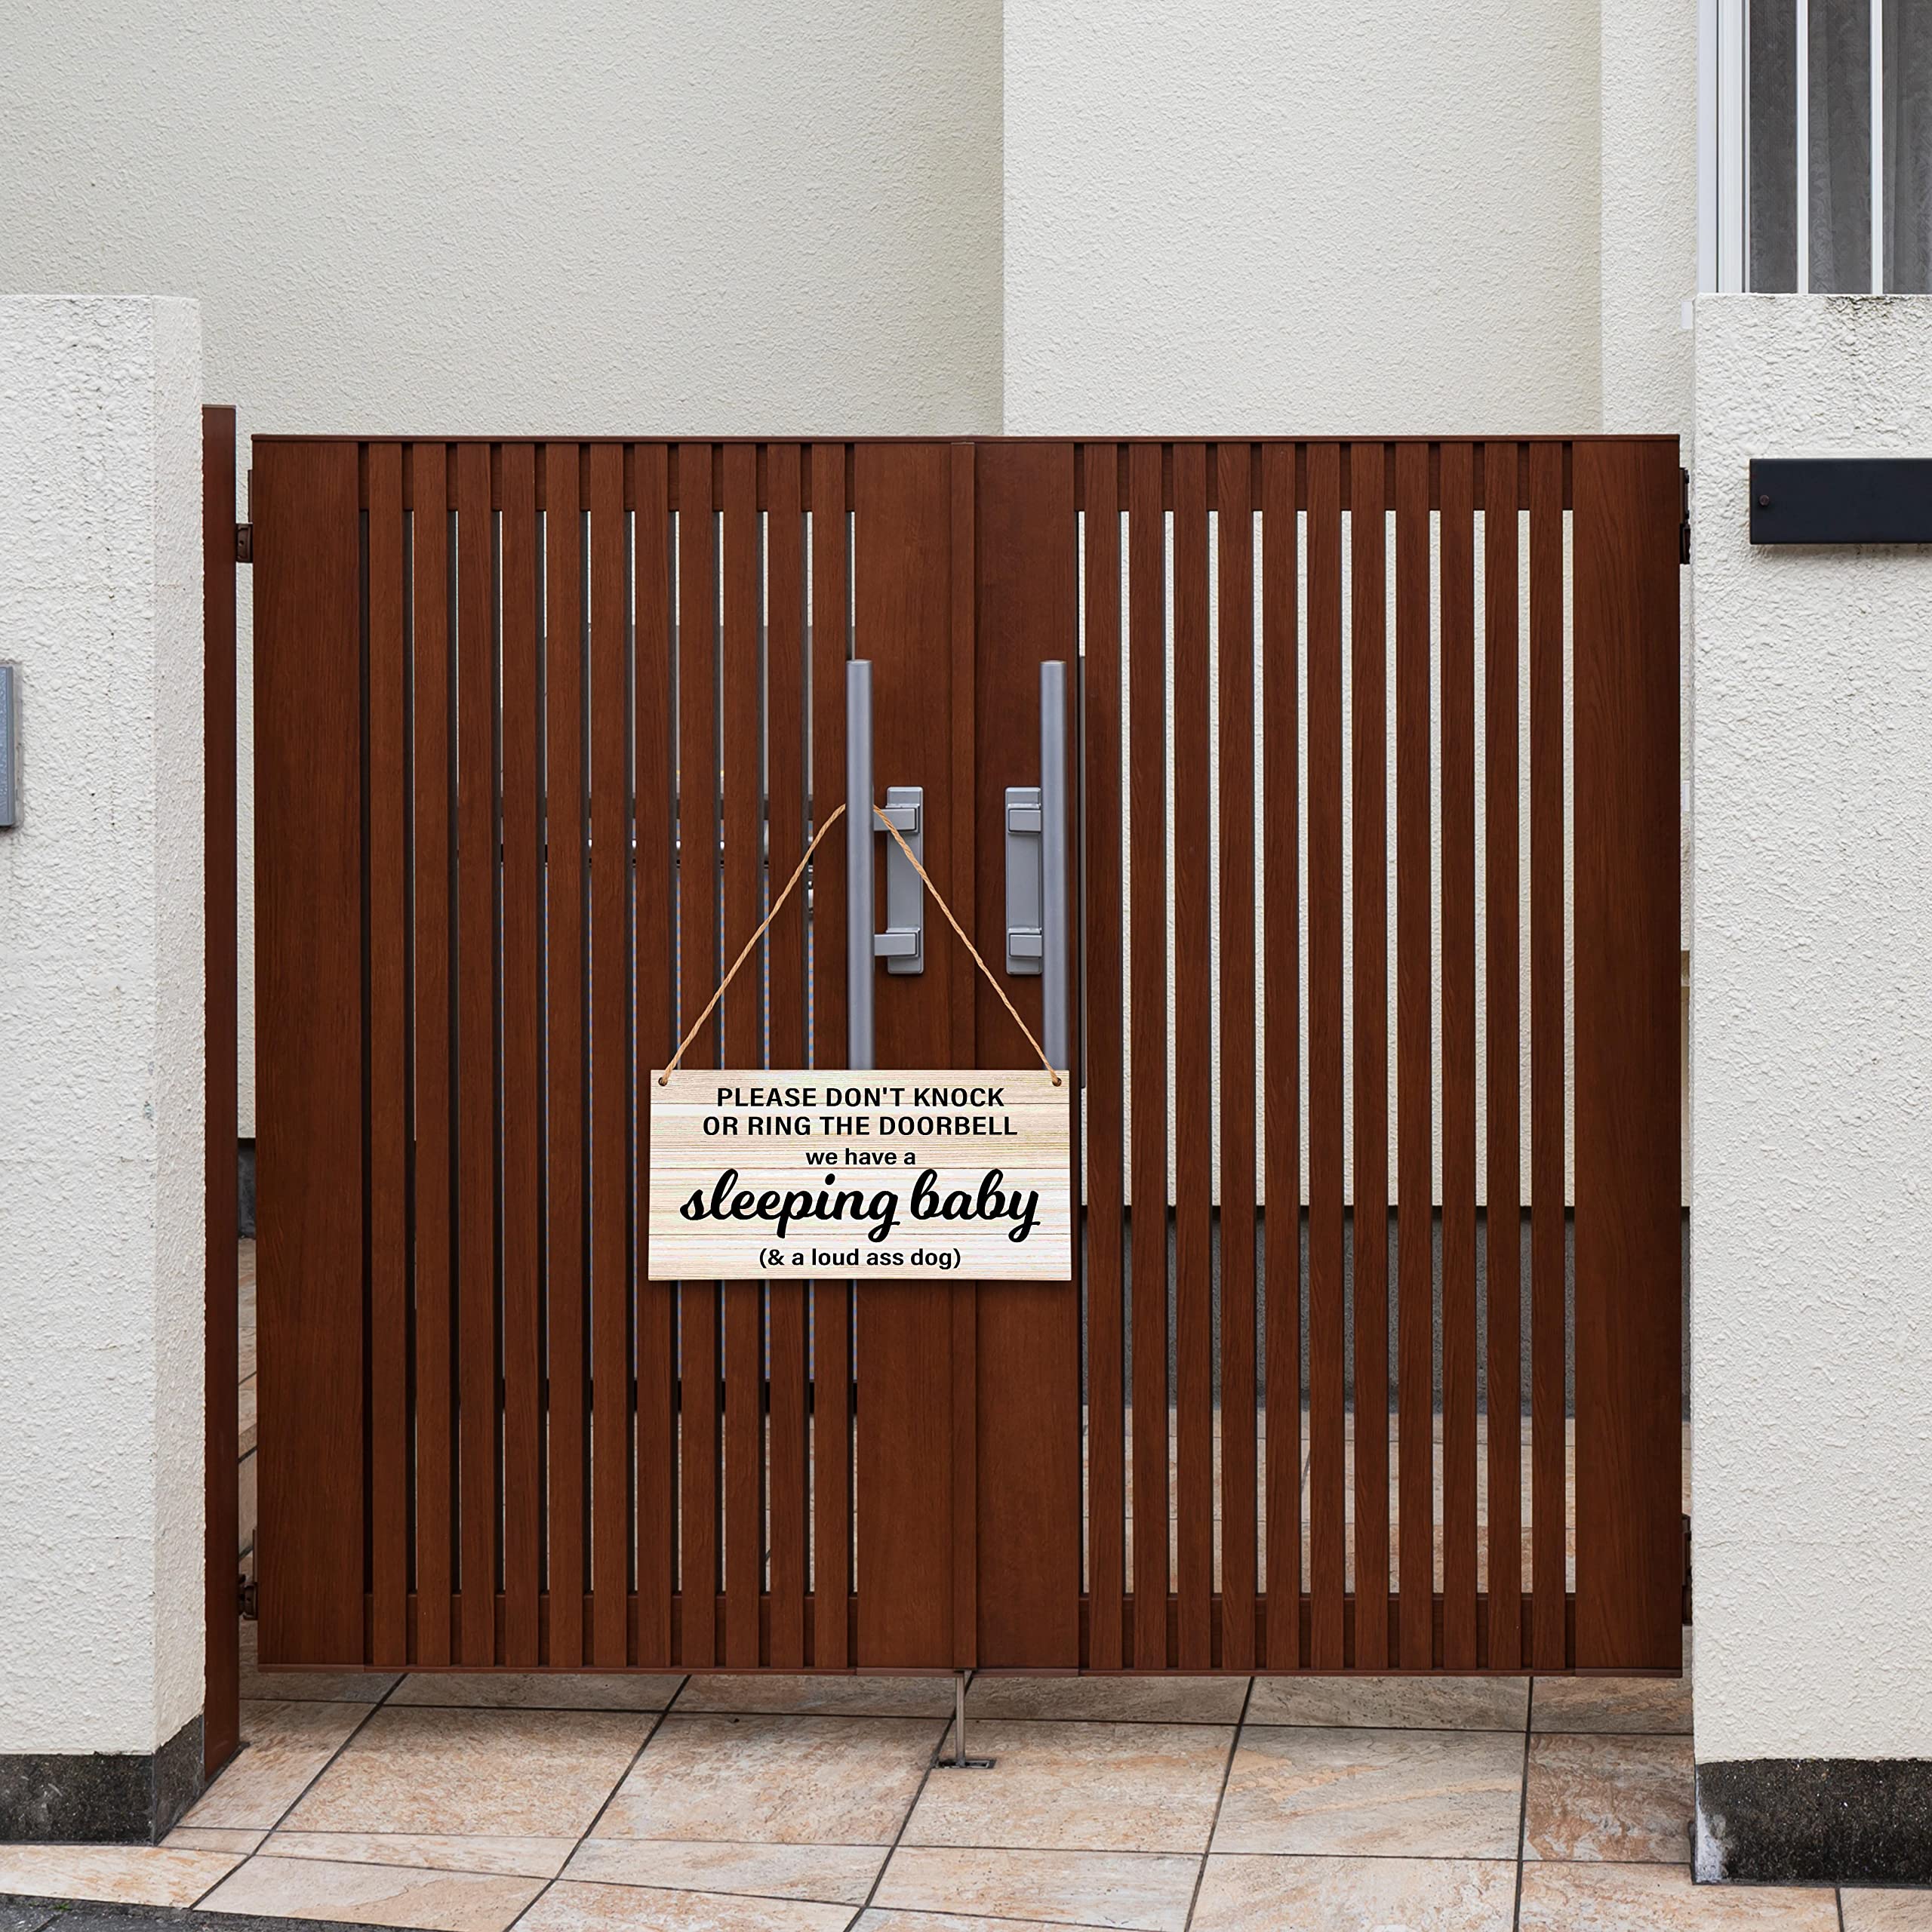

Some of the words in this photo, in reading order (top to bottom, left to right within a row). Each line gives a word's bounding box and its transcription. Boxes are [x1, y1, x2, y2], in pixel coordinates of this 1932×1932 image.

[717, 1088, 817, 1107] PLEASE
[826, 1087, 906, 1107] DON'T
[914, 1088, 1004, 1107] KNOCK
[703, 1116, 738, 1136] OR
[748, 1116, 811, 1136] RING
[819, 1116, 870, 1136] THE
[879, 1116, 1018, 1136] DOORBELL
[805, 1152, 838, 1165] we
[844, 1147, 897, 1165] have
[903, 1152, 915, 1165] a
[679, 1168, 901, 1243] sleeping
[910, 1168, 1041, 1243] baby
[759, 1247, 785, 1269] (&
[792, 1252, 804, 1266] a
[812, 1247, 859, 1266] loud
[866, 1252, 904, 1266] ass
[910, 1247, 961, 1270] dog)
